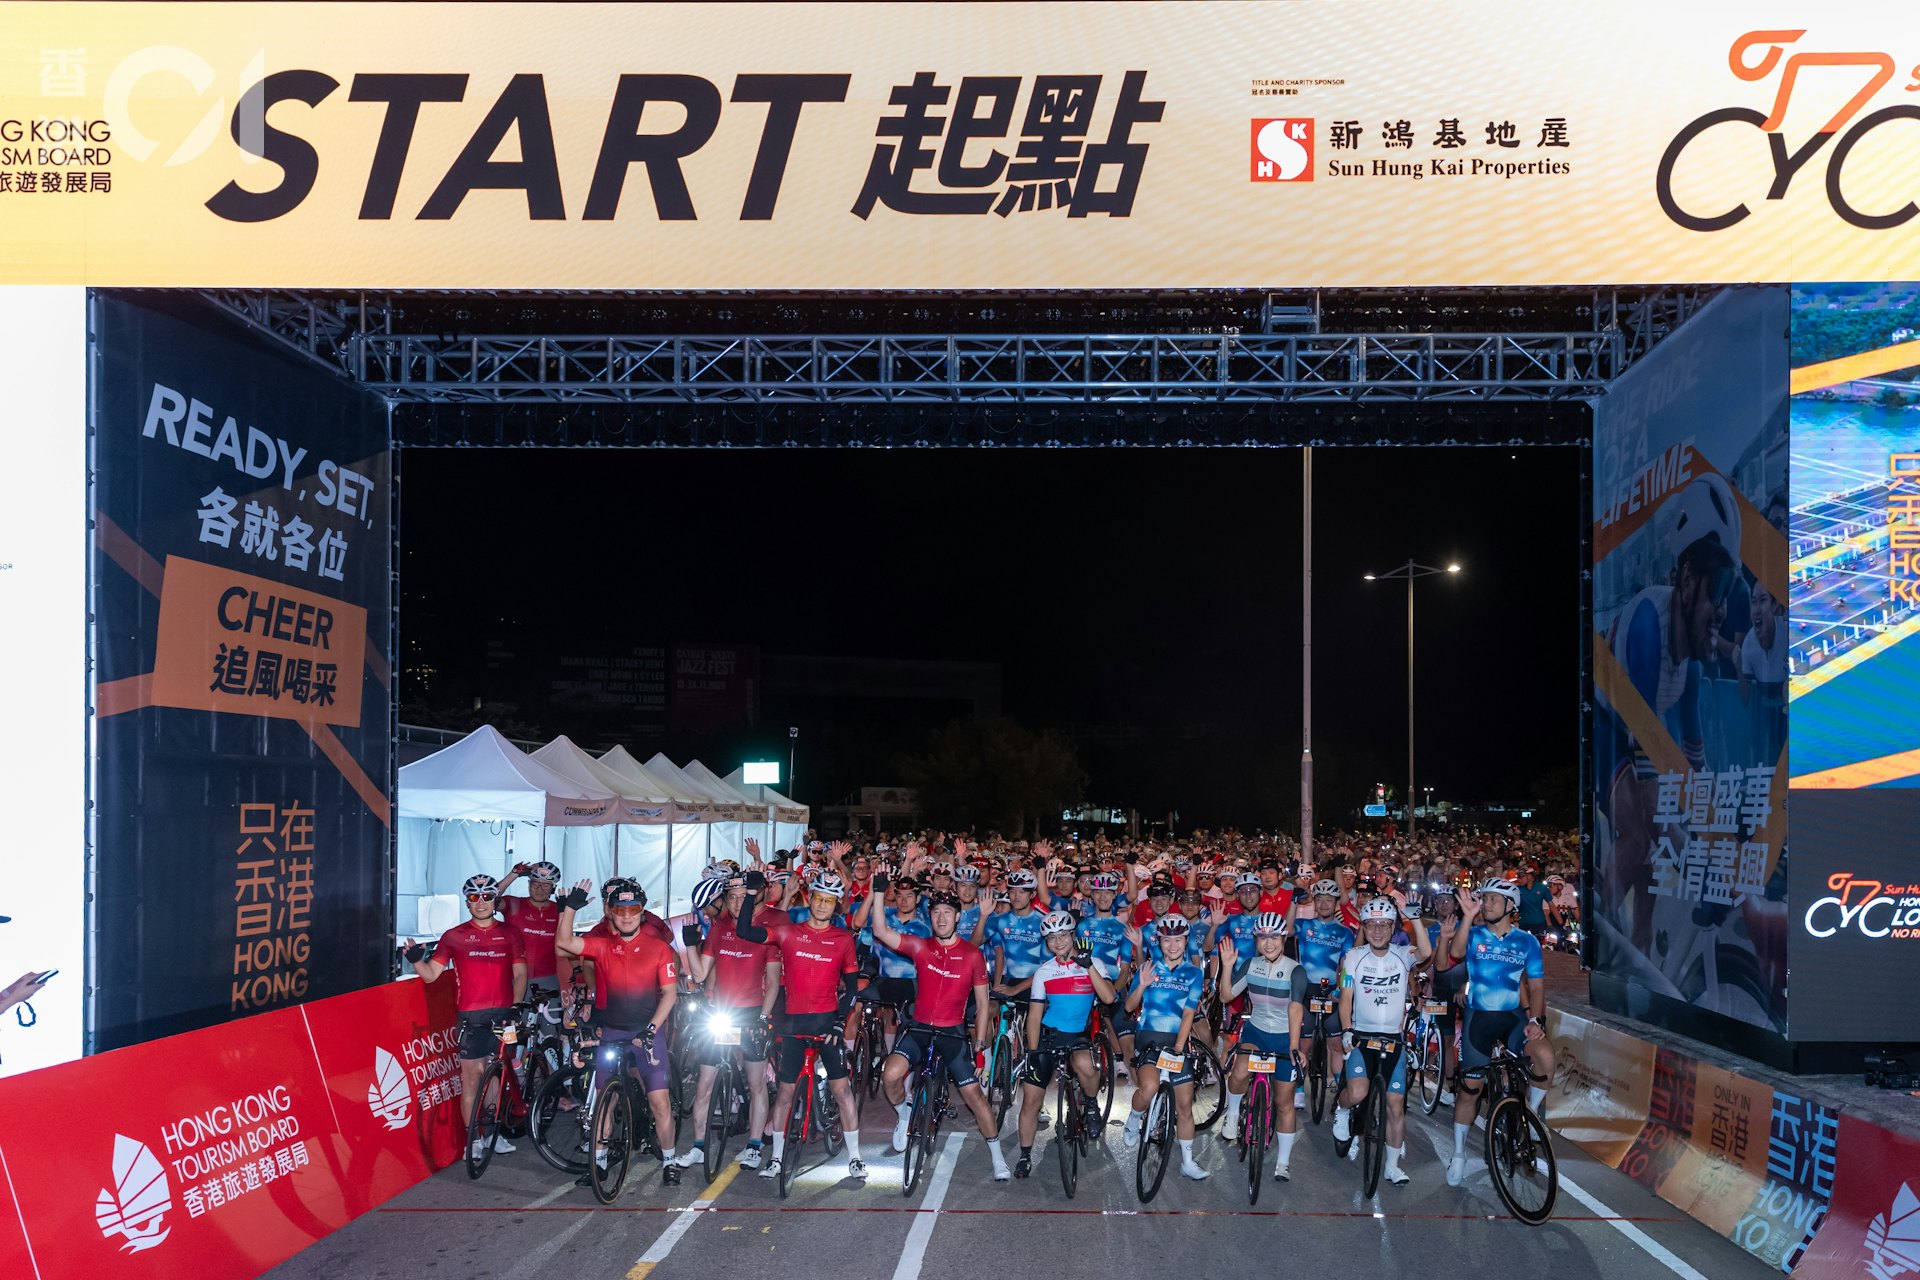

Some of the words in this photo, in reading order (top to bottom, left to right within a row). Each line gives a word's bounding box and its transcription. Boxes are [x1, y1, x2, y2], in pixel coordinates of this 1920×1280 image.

[1314, 78, 1346, 86] SPONSOR
[31, 119, 111, 143] KONG
[205, 69, 852, 223] START
[850, 70, 1167, 222] 起點
[38, 147, 112, 166] BOARD
[1328, 160, 1364, 177] Sun
[1372, 159, 1424, 180] Hung
[1431, 158, 1464, 176] Kai
[1471, 157, 1571, 179] Properties
[142, 383, 308, 501] READY,
[314, 459, 375, 530] SET,
[1600, 434, 1696, 529] LIFETIME
[197, 486, 349, 582] 各就各位
[217, 586, 334, 650] CHEER
[209, 642, 338, 707] 追風喝采
[1652, 762, 1777, 836] 車壇盛事
[236, 799, 316, 856] 只在
[234, 856, 315, 938] 香港
[1883, 883, 1905, 895] Sun
[1003, 934, 1039, 944] SUPERNOVA
[1305, 935, 1342, 949] SUPERNOVA
[1890, 928, 1910, 938] NO
[233, 932, 311, 975] HONG
[719, 949, 742, 958] SHKP
[796, 950, 821, 960] SHKP
[1476, 953, 1525, 966] SUPERNOVA
[230, 967, 309, 1012] KONG
[1150, 981, 1190, 992] SUPERNOVA
[1360, 973, 1401, 987] EZR
[402, 1032, 444, 1064] HONG
[409, 1055, 455, 1086] TOURISM
[1162, 1060, 1178, 1069] 1145
[1714, 1084, 1739, 1107] ONLY
[1740, 1093, 1751, 1112] IN
[161, 1106, 232, 1154] HONG
[231, 1085, 291, 1128] KONG
[1711, 1102, 1749, 1161] 香港
[172, 1136, 249, 1184] TOURISM
[247, 1115, 299, 1153] BOARD
[183, 1140, 310, 1219] 香港旅遊發展局
